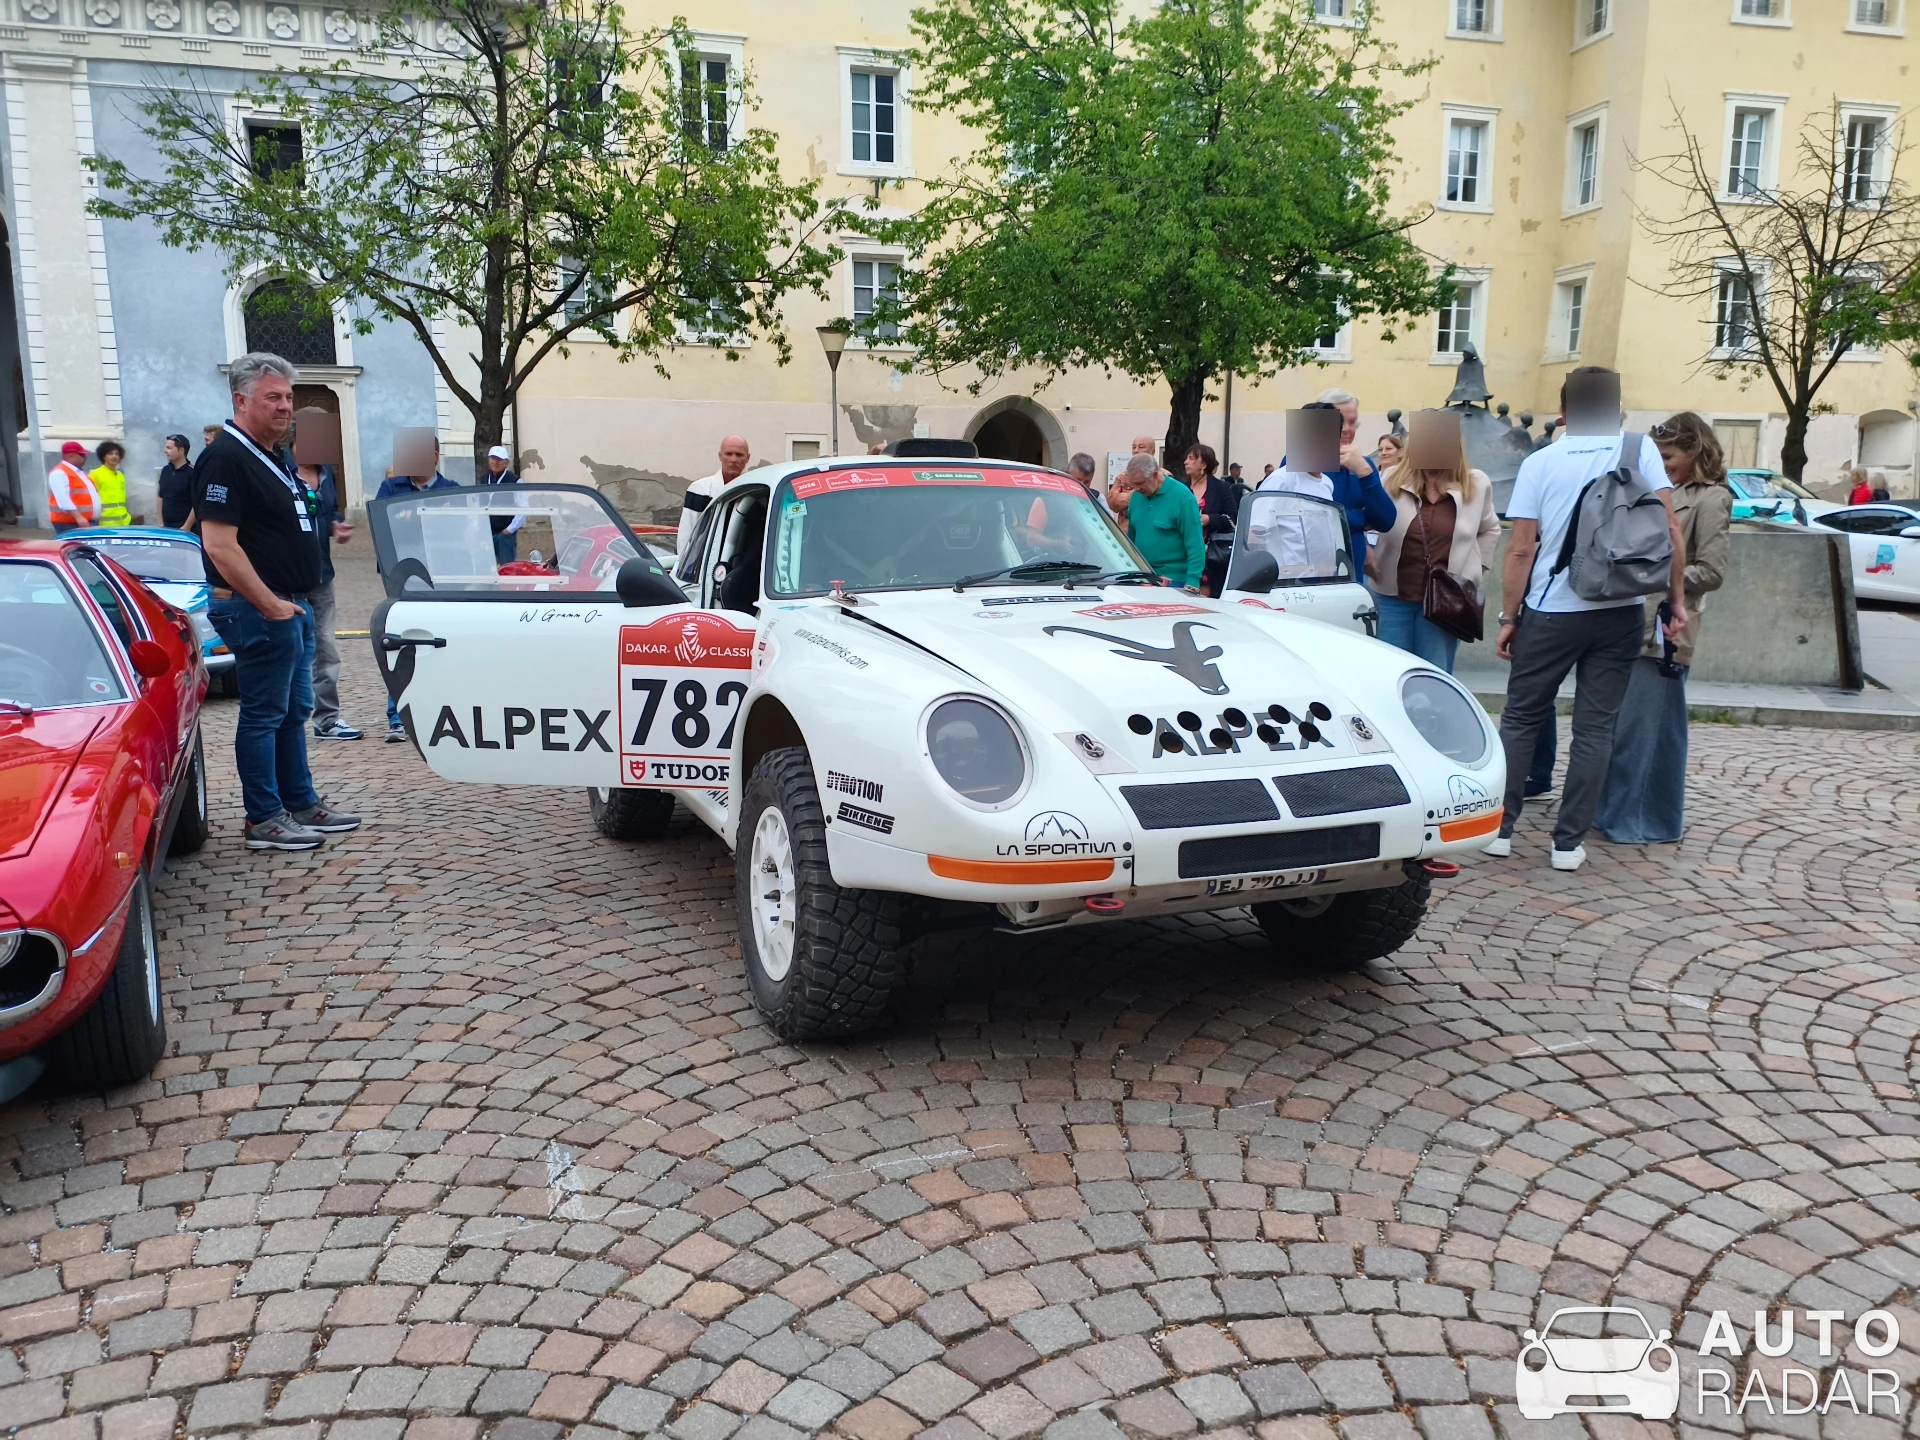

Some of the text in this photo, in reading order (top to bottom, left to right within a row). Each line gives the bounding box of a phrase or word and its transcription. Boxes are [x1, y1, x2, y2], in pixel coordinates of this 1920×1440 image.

[797, 482, 817, 491] 2026
[110, 539, 171, 548] Beretta
[696, 615, 722, 628] EDITION
[630, 678, 749, 750] 782
[429, 705, 614, 753] ALPEX
[1436, 797, 1500, 819] LA SPORTIVA
[836, 801, 896, 835] SIKKENS
[996, 841, 1117, 856] LA SPORTIVA
